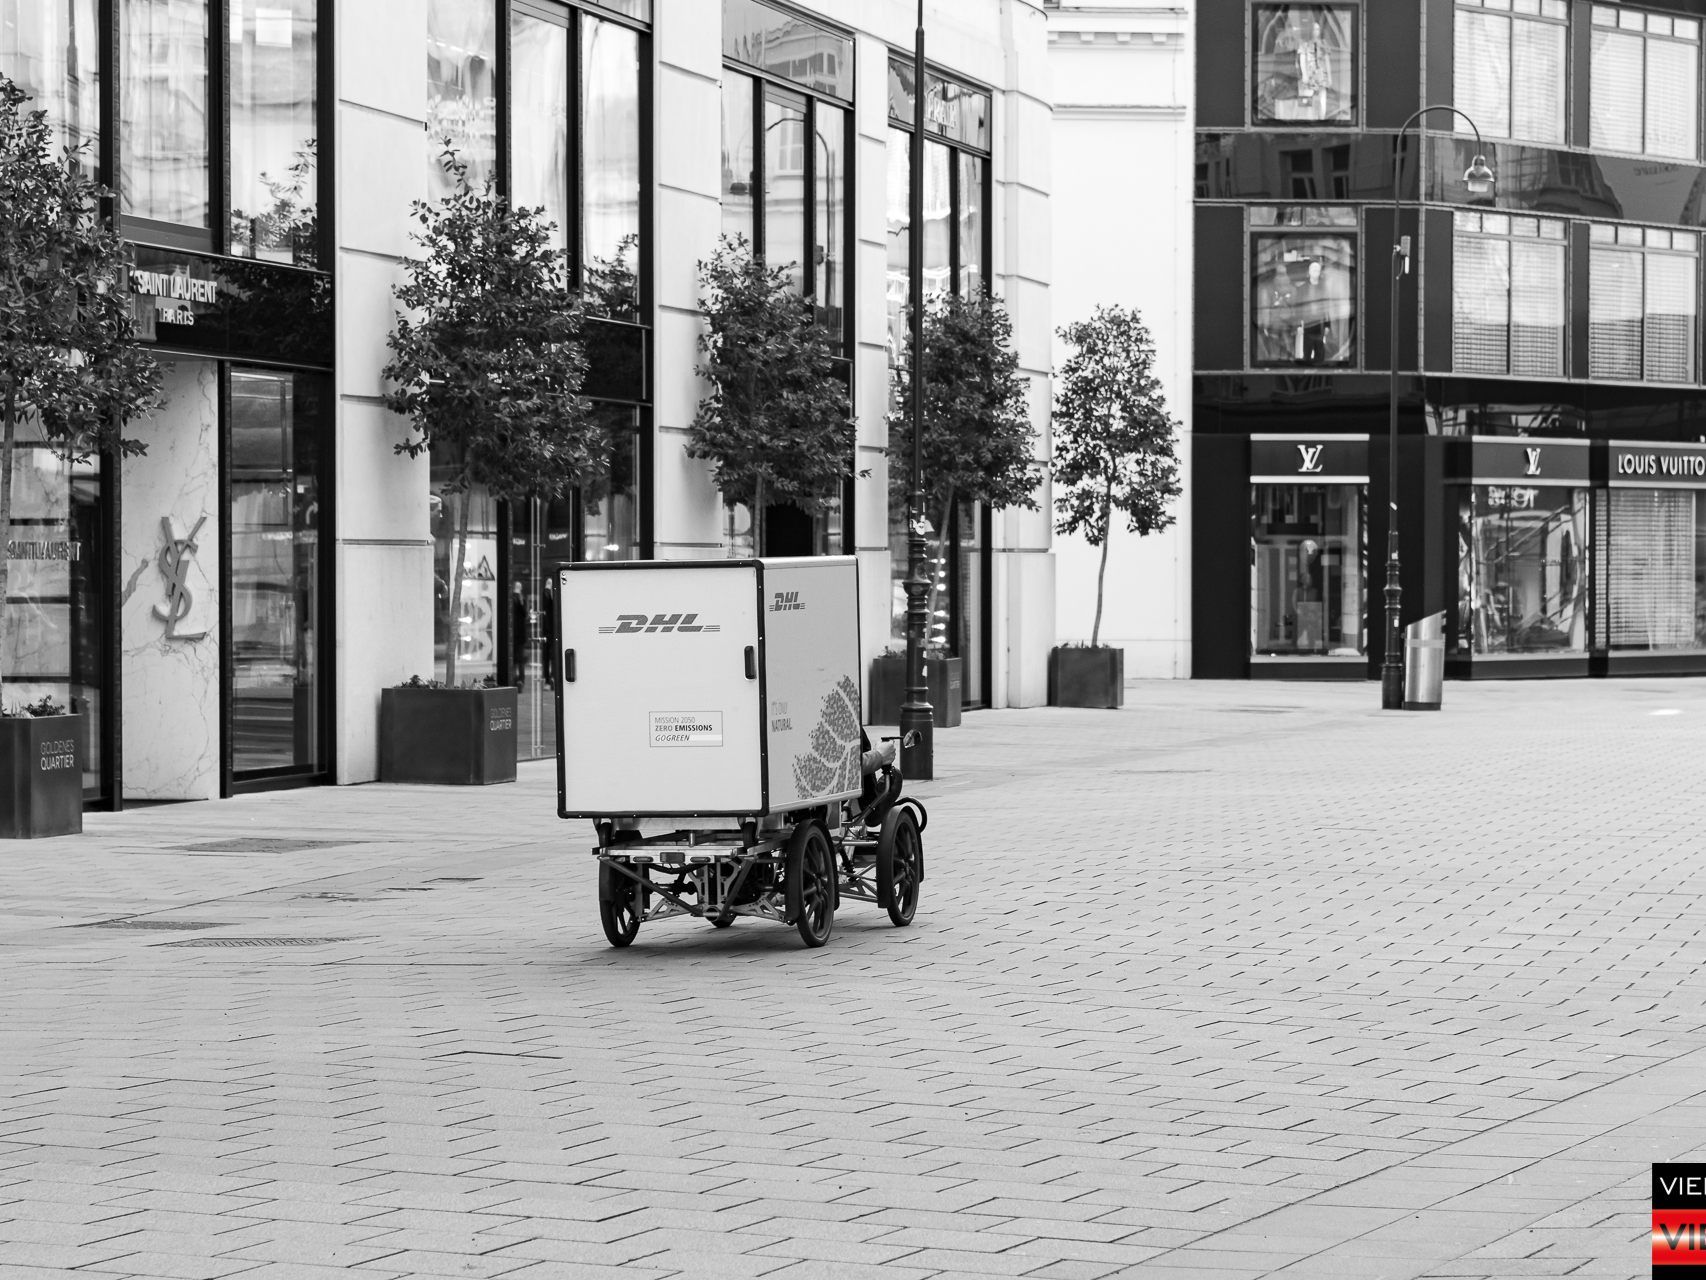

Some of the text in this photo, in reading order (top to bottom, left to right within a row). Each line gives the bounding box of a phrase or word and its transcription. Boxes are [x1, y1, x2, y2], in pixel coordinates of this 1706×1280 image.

[134, 270, 217, 303] SAINT LAURENT
[161, 307, 194, 326] PARIS
[1618, 453, 1657, 475] LOUIS
[771, 591, 803, 612] DHL
[614, 613, 704, 634] DHL
[654, 716, 696, 724] MISSION 2050
[655, 724, 713, 732] ZERO EMISSIONS
[655, 734, 690, 742] GOGREEN
[40, 754, 74, 770] QUARTIER
